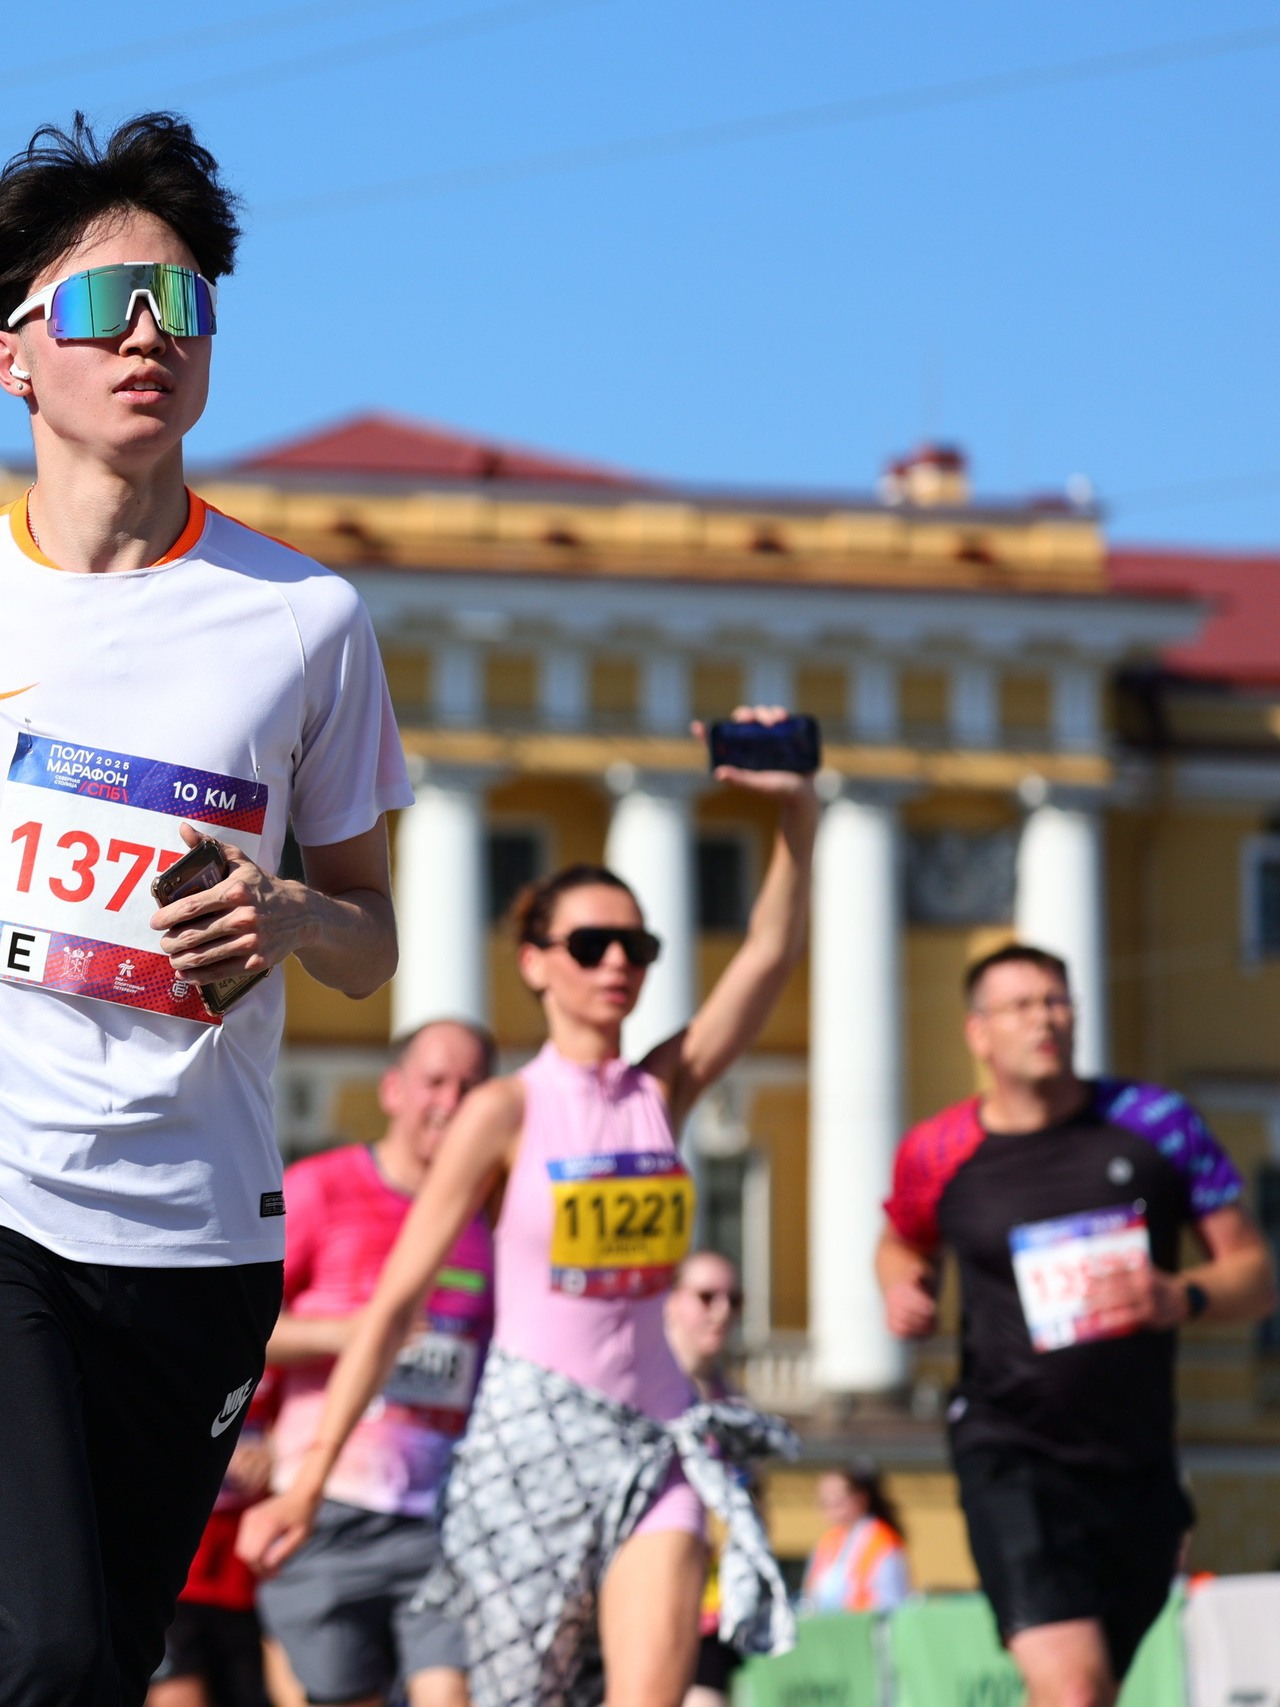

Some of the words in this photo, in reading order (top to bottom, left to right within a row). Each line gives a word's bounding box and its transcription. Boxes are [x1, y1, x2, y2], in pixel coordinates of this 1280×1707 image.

[46, 758, 128, 787] МАРАФОН
[50, 744, 95, 764] ПОЛУ
[96, 756, 130, 770] 2025
[173, 781, 198, 802] 10
[11, 821, 186, 912] 137
[564, 1189, 686, 1240] 11221
[220, 1377, 253, 1419] NIKE
